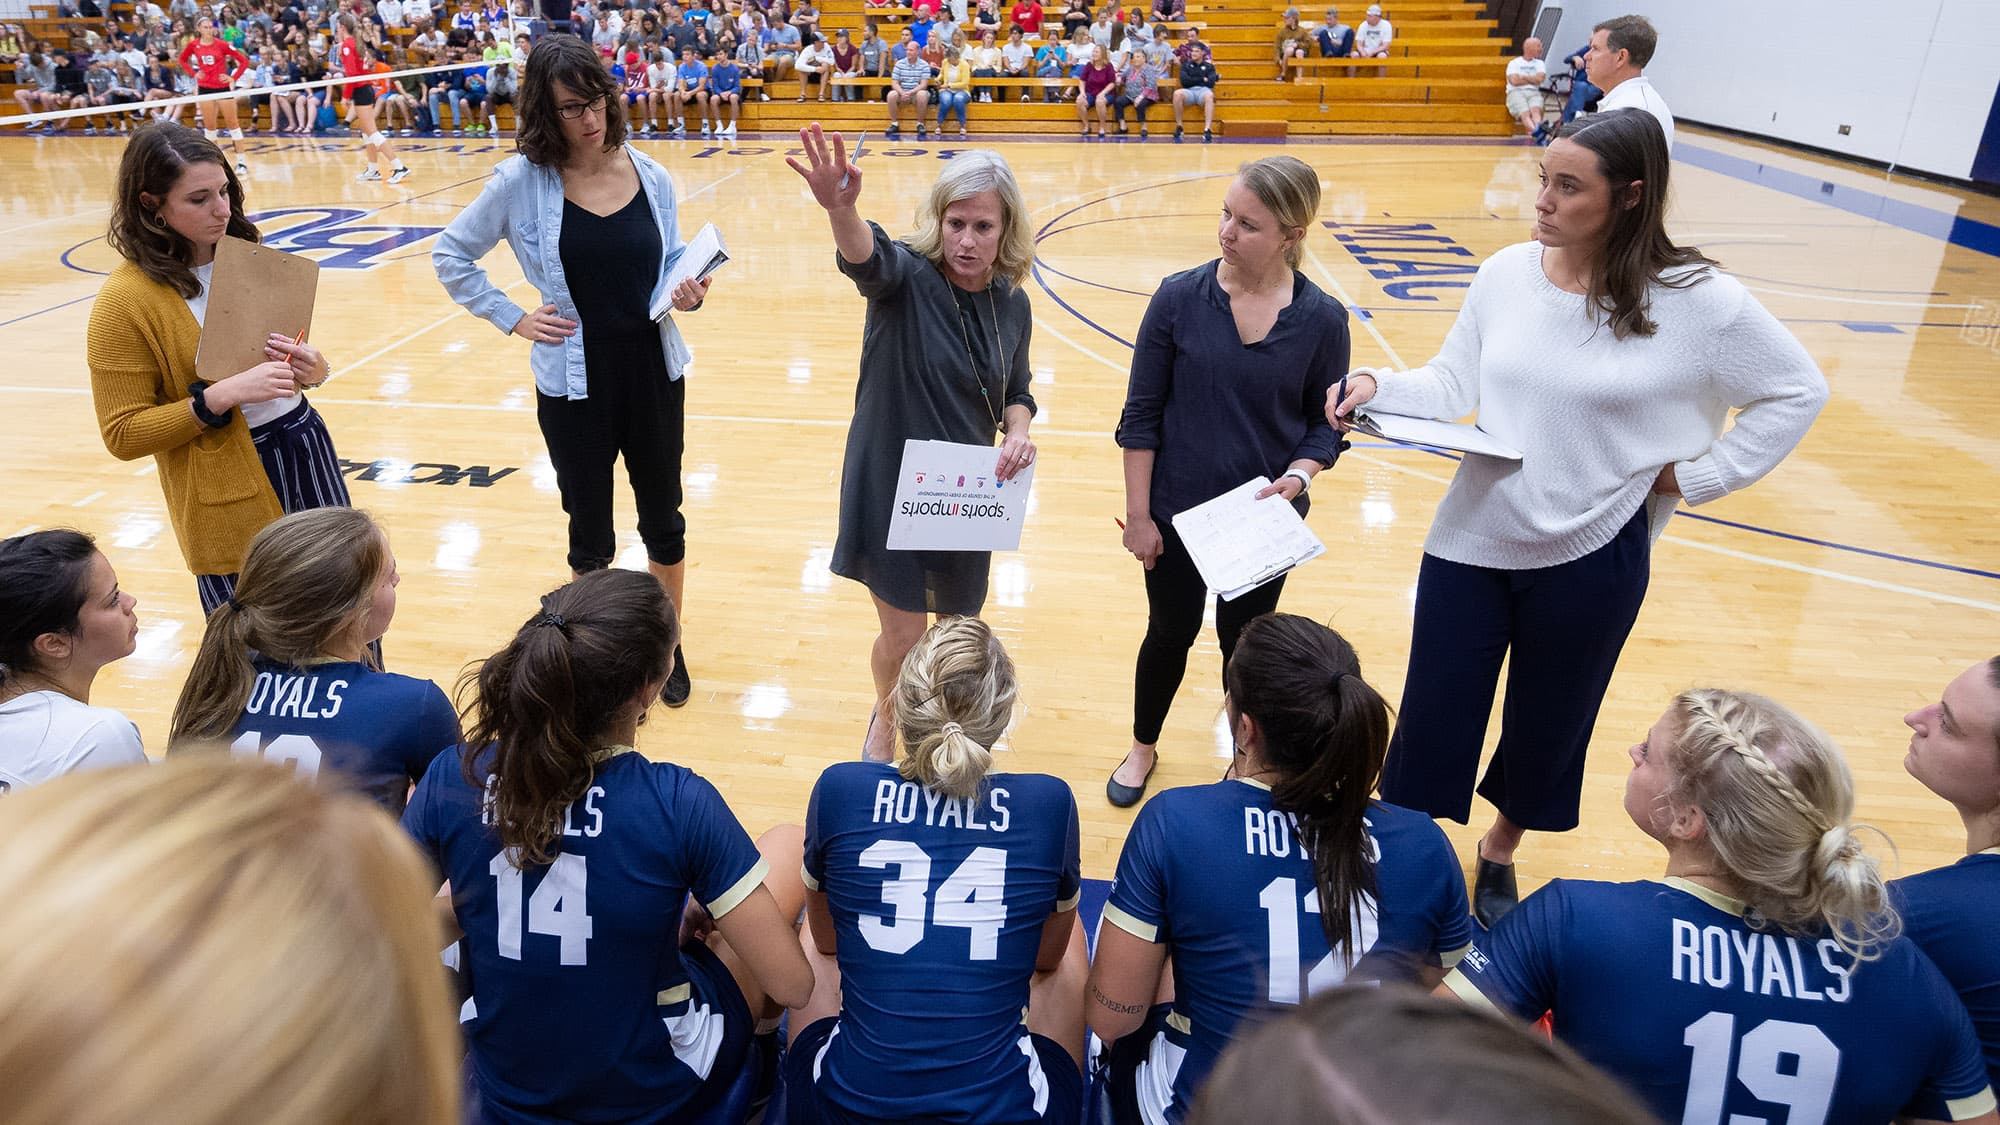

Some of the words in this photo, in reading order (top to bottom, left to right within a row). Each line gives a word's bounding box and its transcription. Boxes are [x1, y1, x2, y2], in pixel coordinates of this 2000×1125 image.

[961, 501, 1005, 519] sports
[246, 671, 348, 719] OYALS
[872, 779, 1010, 832] ROYALS
[489, 842, 593, 966] 14
[858, 839, 1008, 961] 34
[1672, 917, 1851, 1003] ROYALS
[1681, 1010, 1840, 1125] 19
